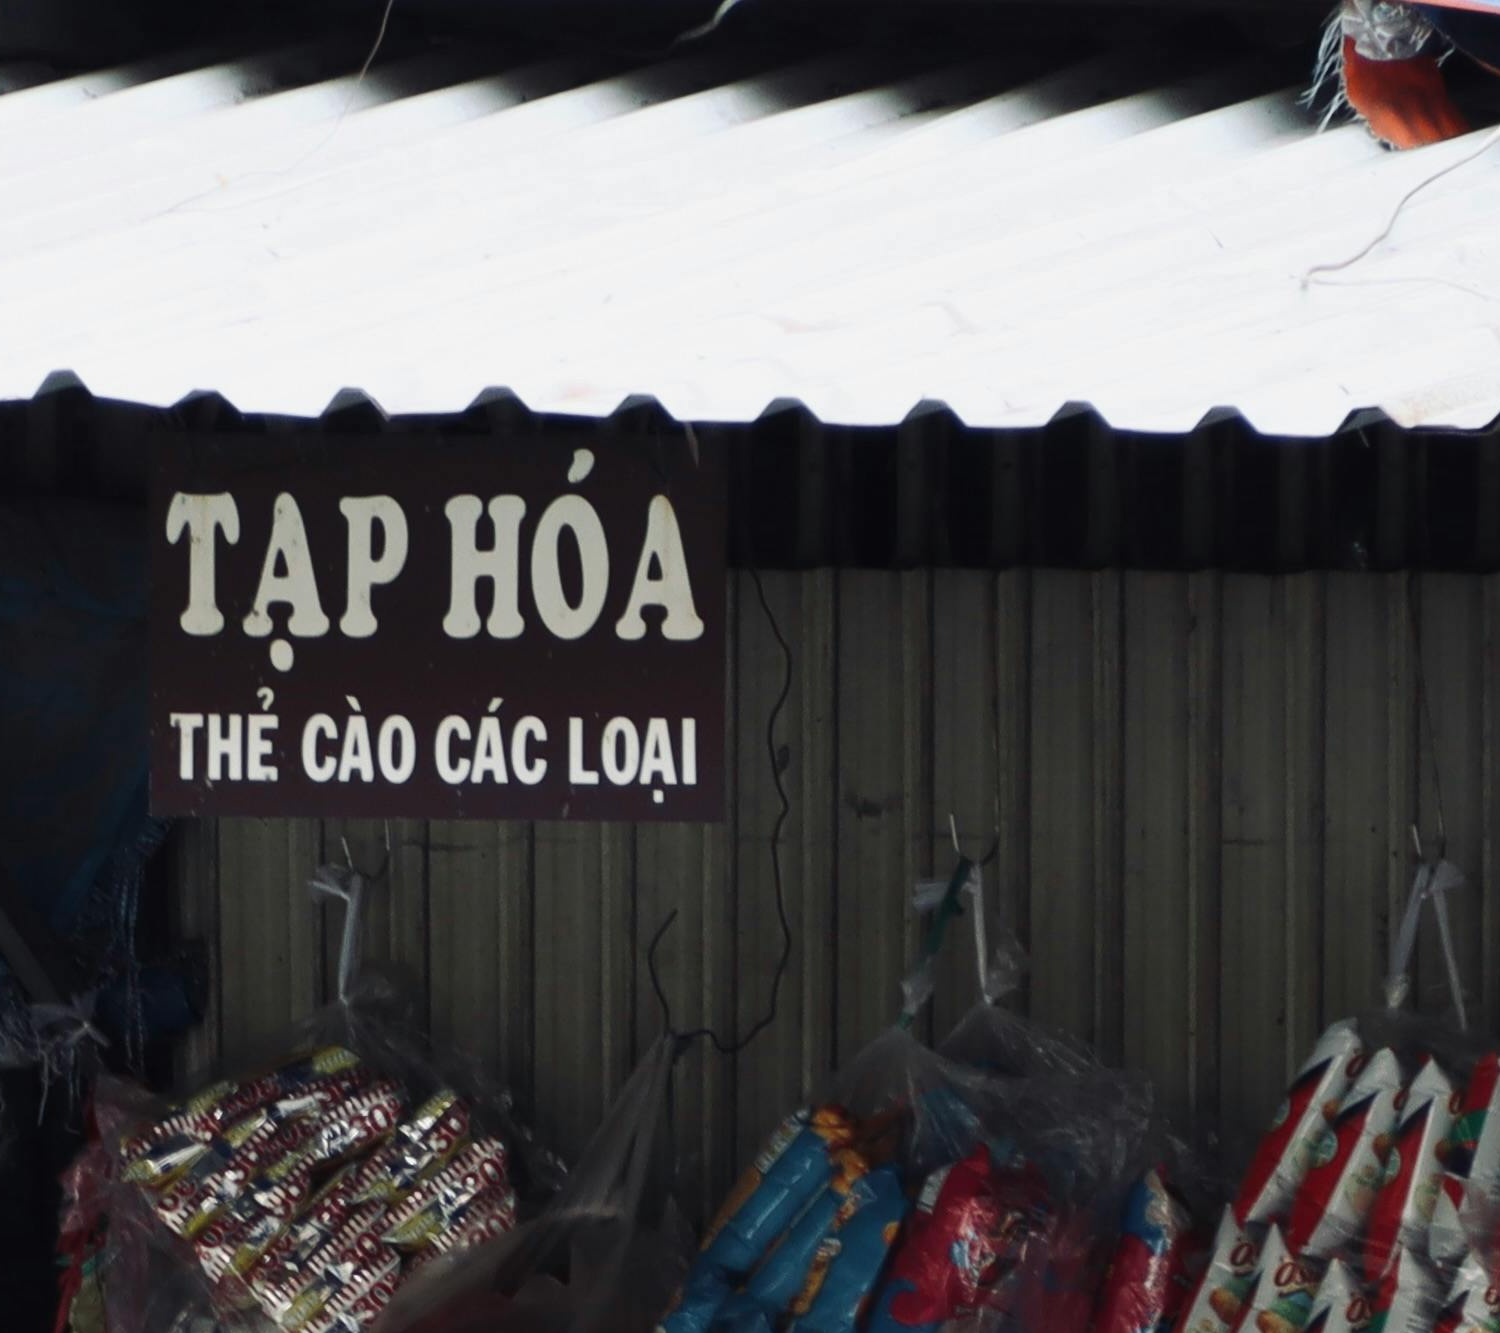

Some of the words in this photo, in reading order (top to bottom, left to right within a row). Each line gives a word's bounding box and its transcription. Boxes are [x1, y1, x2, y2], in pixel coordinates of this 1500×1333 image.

[165, 491, 409, 672] TẠP
[443, 449, 705, 641] HÓA
[169, 687, 280, 781] THẺ
[301, 696, 417, 784] CÀO
[434, 698, 549, 786] CÁC
[568, 717, 697, 803] LOẠI
